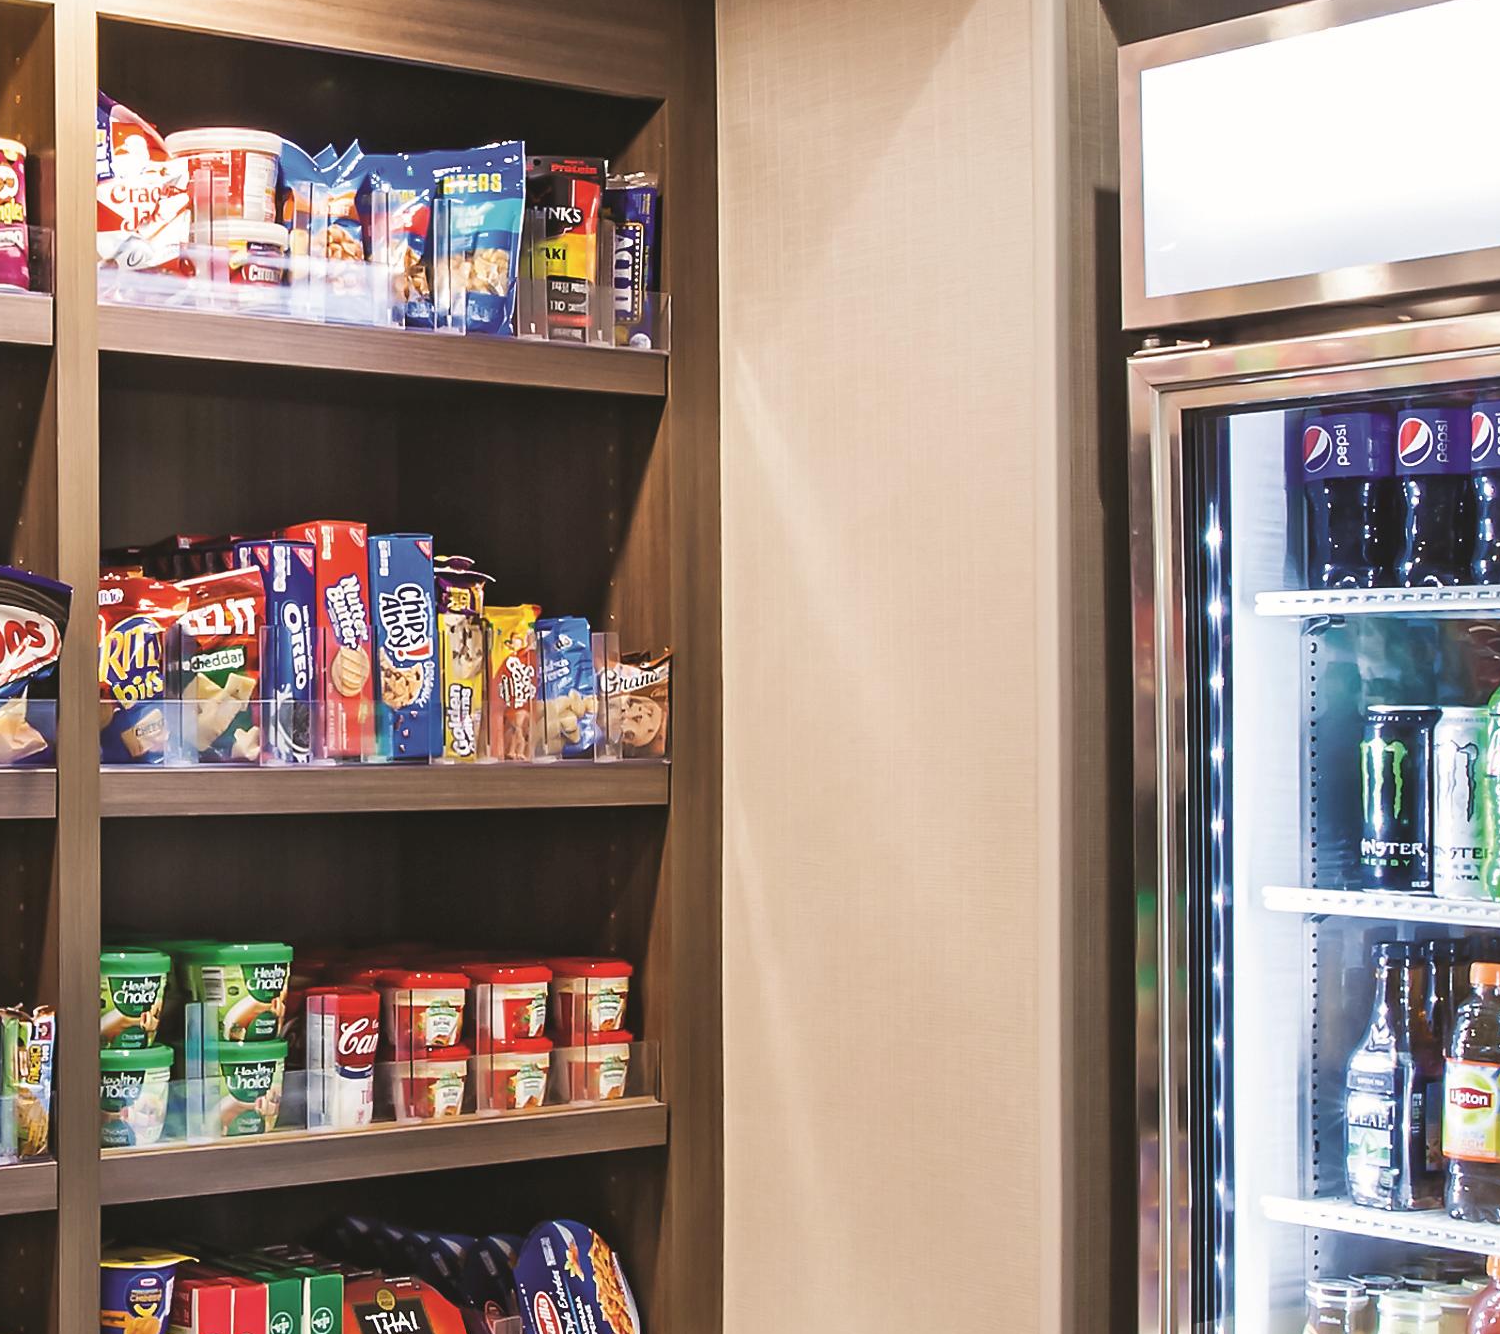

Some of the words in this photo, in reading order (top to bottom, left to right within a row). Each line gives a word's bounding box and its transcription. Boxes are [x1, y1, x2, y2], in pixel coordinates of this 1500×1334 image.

[1333, 423, 1350, 467] pepsi
[1434, 419, 1449, 464] pepsi
[326, 586, 359, 651] Butter
[338, 574, 369, 642] Nutter
[396, 584, 427, 645] Chips
[282, 601, 308, 690] OREO
[112, 989, 157, 1006] Choice
[121, 977, 161, 996] Healthy
[1449, 1087, 1492, 1107] Lipton
